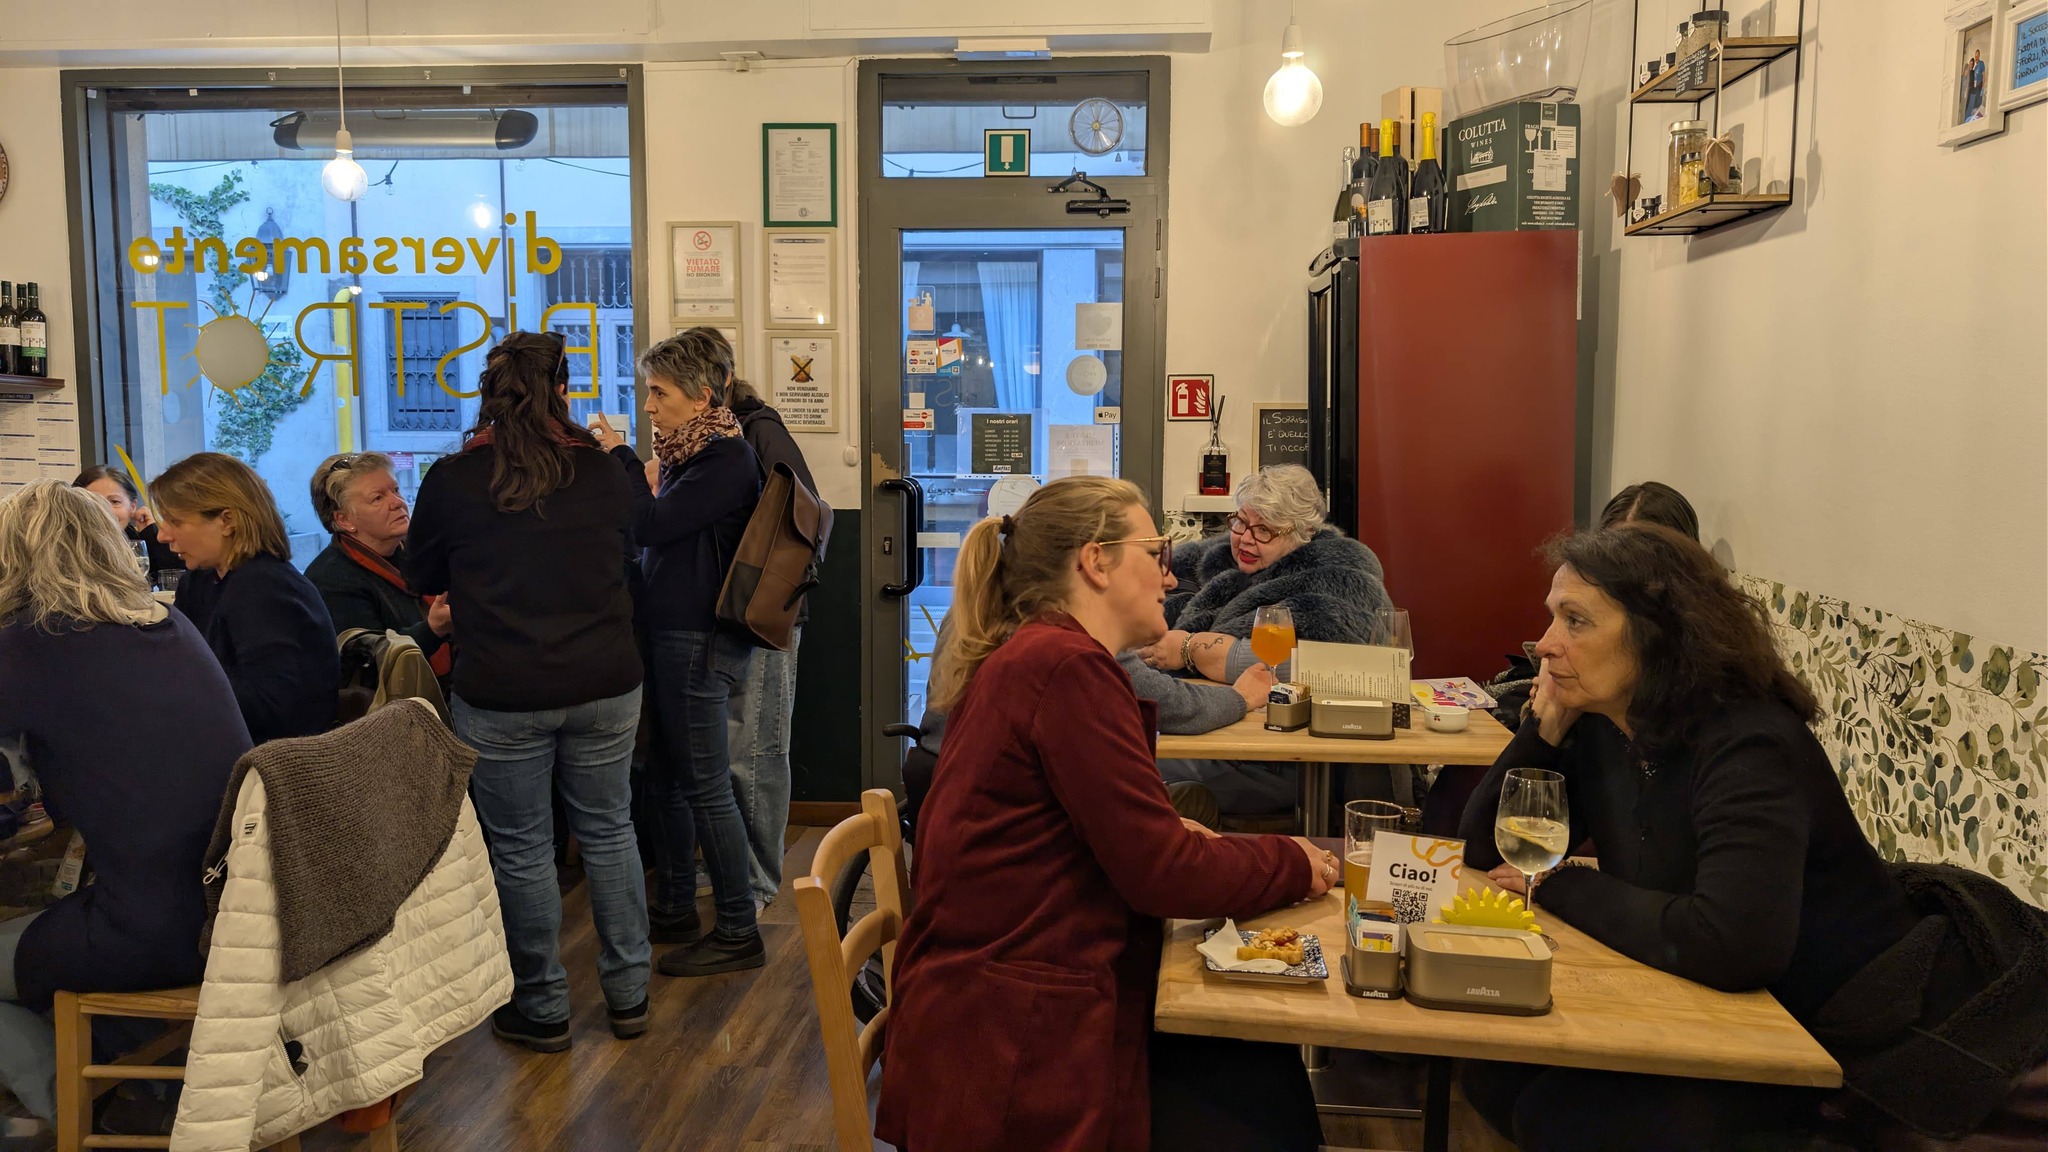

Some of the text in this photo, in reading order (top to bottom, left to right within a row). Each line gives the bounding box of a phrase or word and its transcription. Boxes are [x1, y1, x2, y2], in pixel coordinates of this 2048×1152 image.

[1459, 118, 1506, 141] COLUTTA
[1470, 138, 1492, 148] WINES
[1104, 411, 1116, 420] Pay
[1266, 444, 1276, 452] TI
[1389, 863, 1437, 884] Ciao!
[1362, 990, 1388, 998] LAVAZZA
[1466, 986, 1500, 997] LAVAZZA
